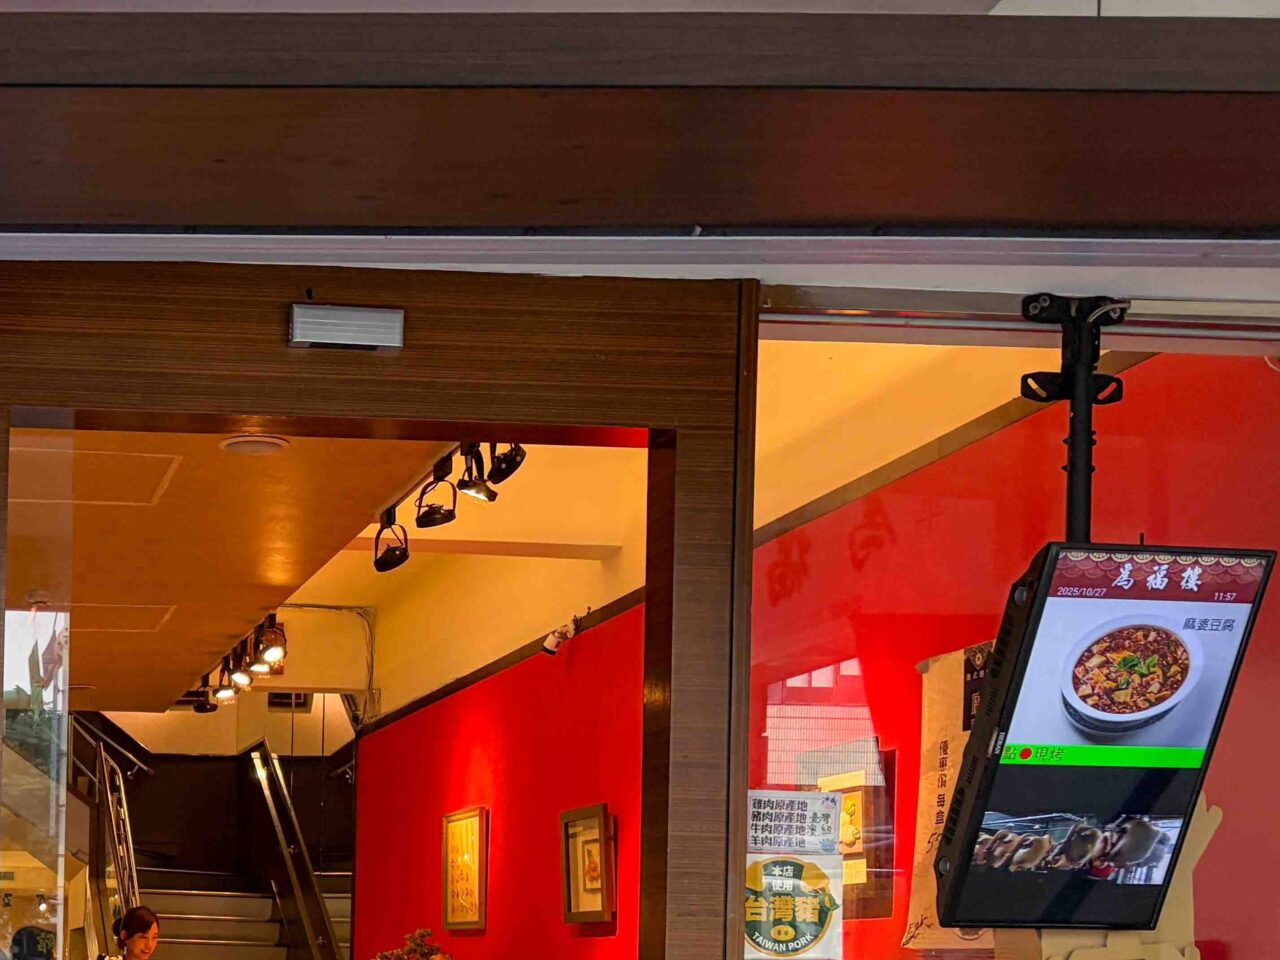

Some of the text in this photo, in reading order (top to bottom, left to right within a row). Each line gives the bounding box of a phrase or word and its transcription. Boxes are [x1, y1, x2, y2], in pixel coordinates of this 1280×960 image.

[1057, 587, 1238, 601] 2025/10/27 11:57
[1182, 617, 1236, 632] 麻婆豆腐
[752, 798, 808, 812] 雞肉原產地
[751, 811, 807, 824] 豬肉原產地
[750, 823, 806, 836] 牛肉原產地
[750, 835, 806, 848] 羊肉原產地
[771, 865, 795, 877] 本店
[771, 879, 794, 891] 使用
[752, 931, 815, 952] TAIWAN PORK
